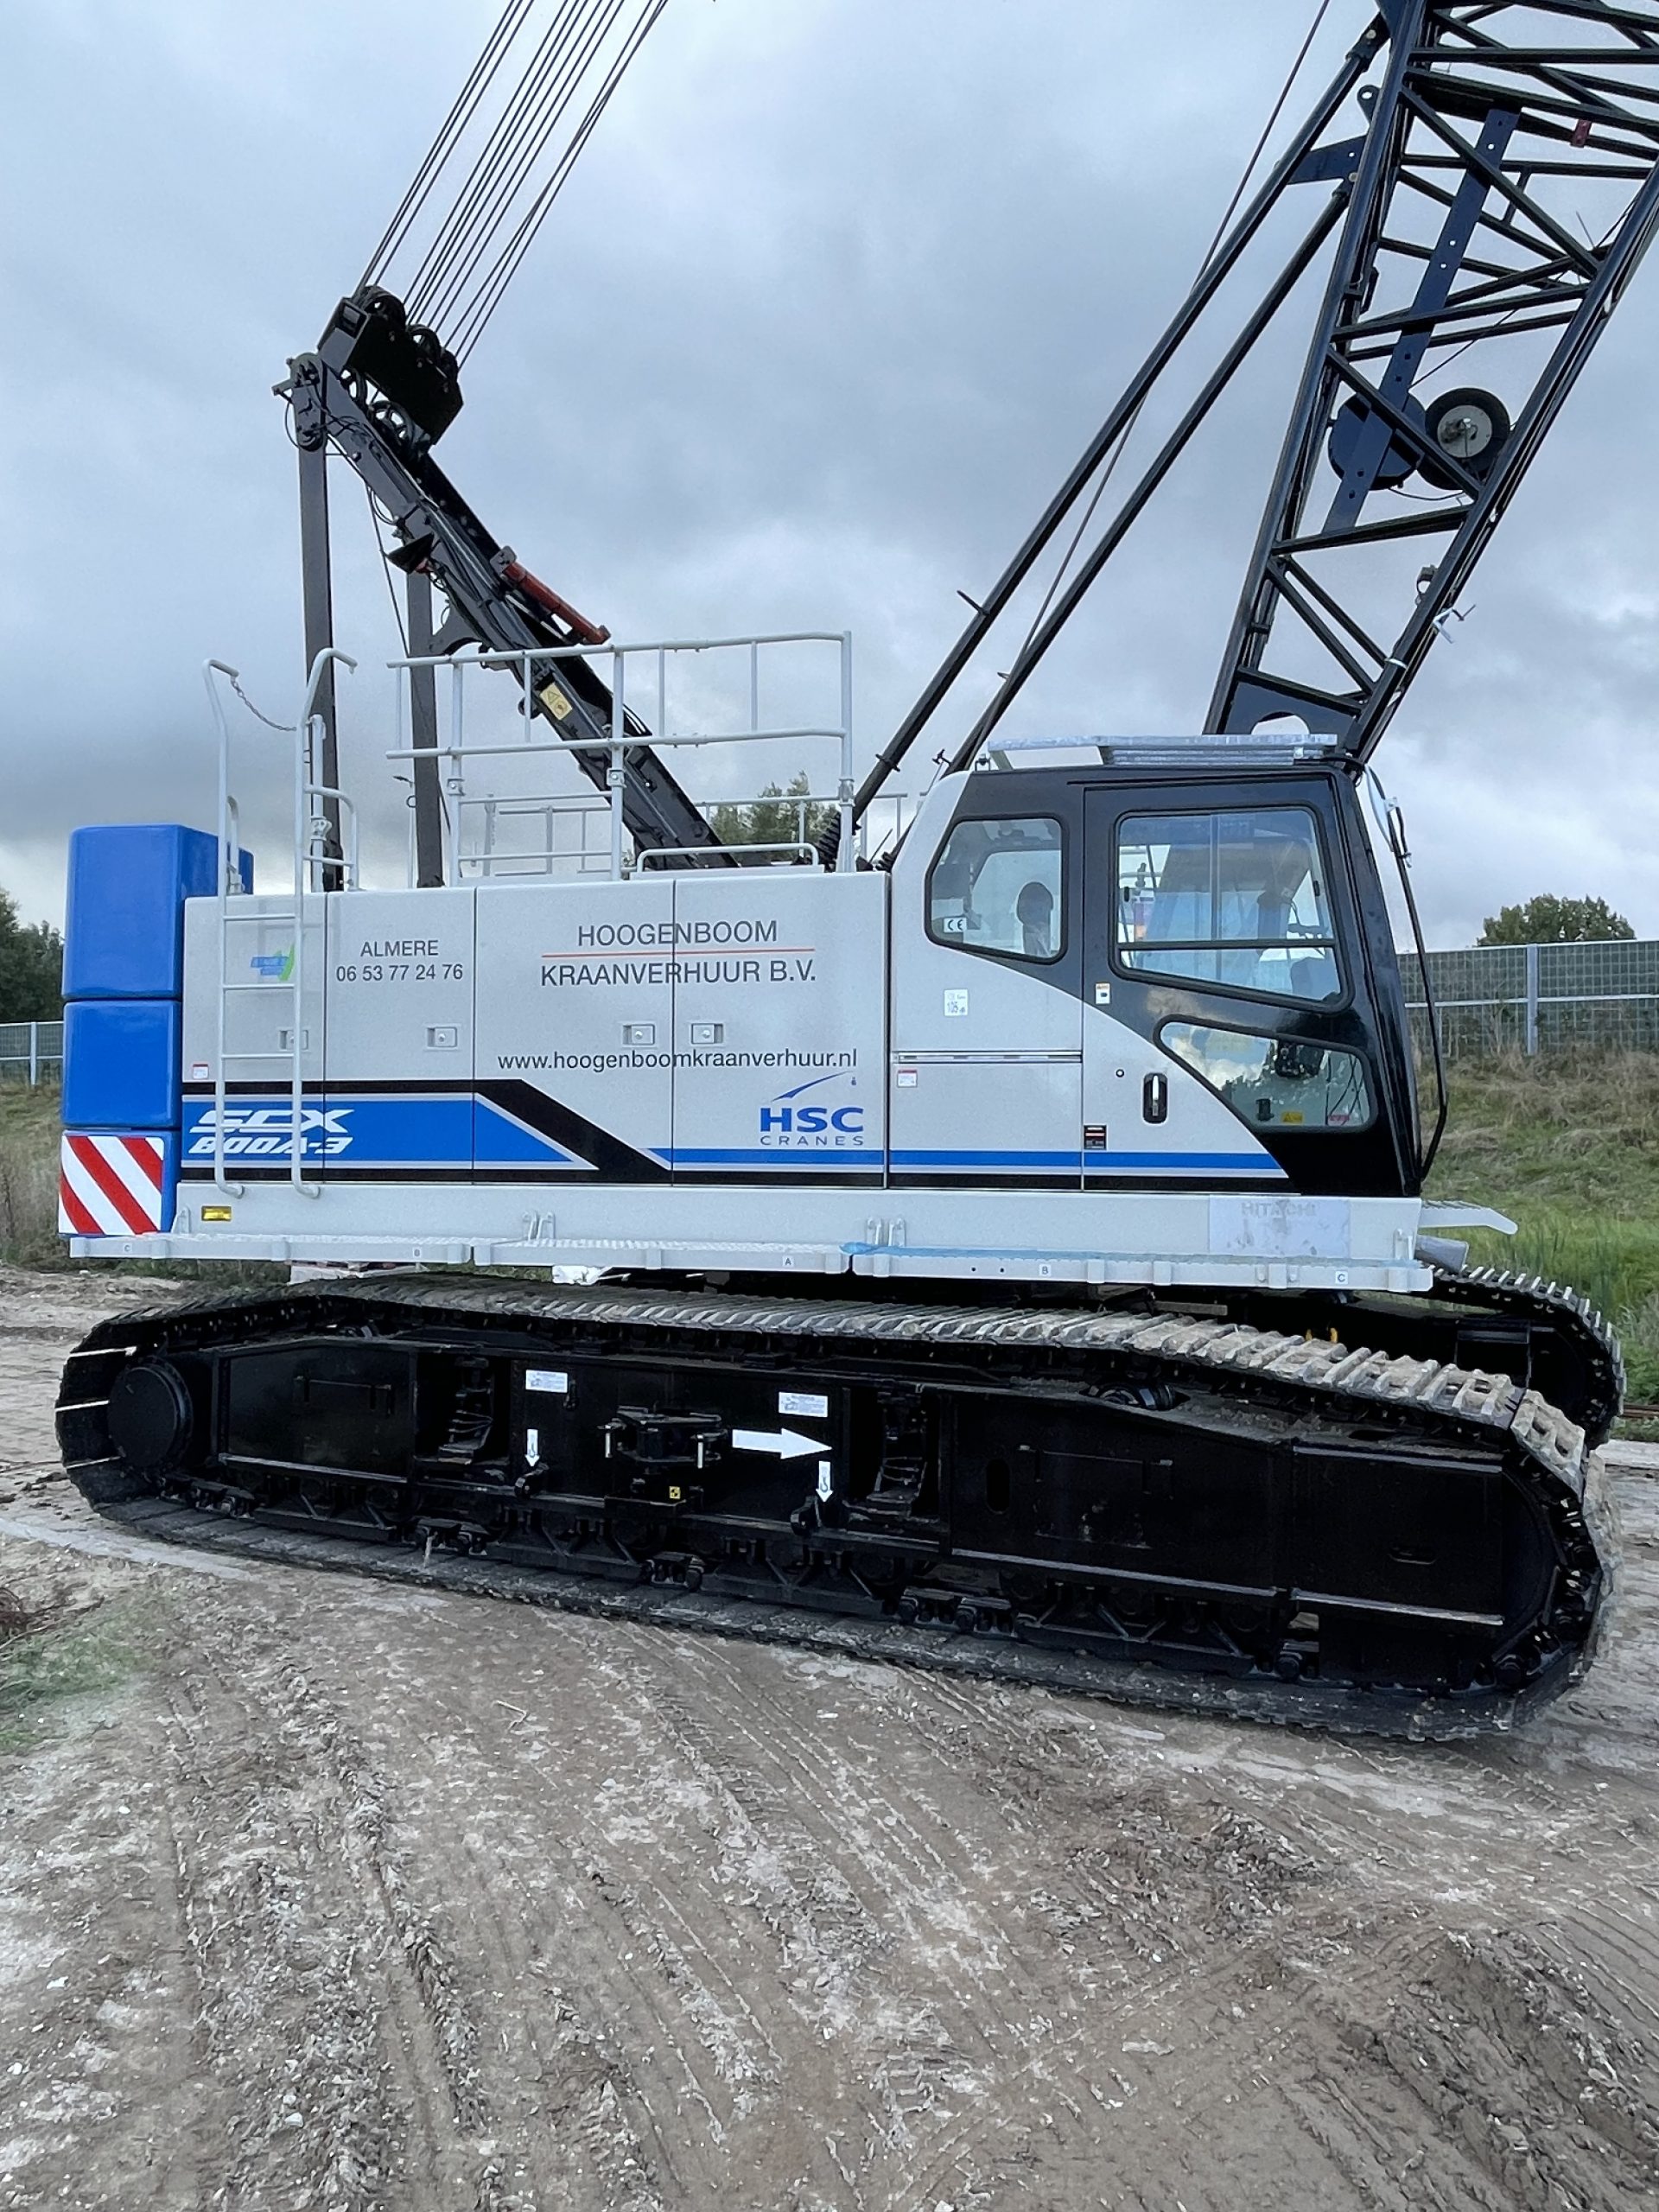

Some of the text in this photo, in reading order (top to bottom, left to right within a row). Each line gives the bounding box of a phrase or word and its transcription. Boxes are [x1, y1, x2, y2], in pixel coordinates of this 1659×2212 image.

[578, 920, 777, 946] HOOGENBOOM
[948, 919, 963, 931] CE
[360, 939, 439, 957] ALMERE
[336, 963, 463, 982] 06 53 77 24 76
[541, 959, 816, 986] KRAANVERHUUR B.V.
[498, 1048, 857, 1073] www.hoogenboomkraanverhuur.nl
[760, 1107, 864, 1133] HSC
[760, 1135, 864, 1147] CRANES
